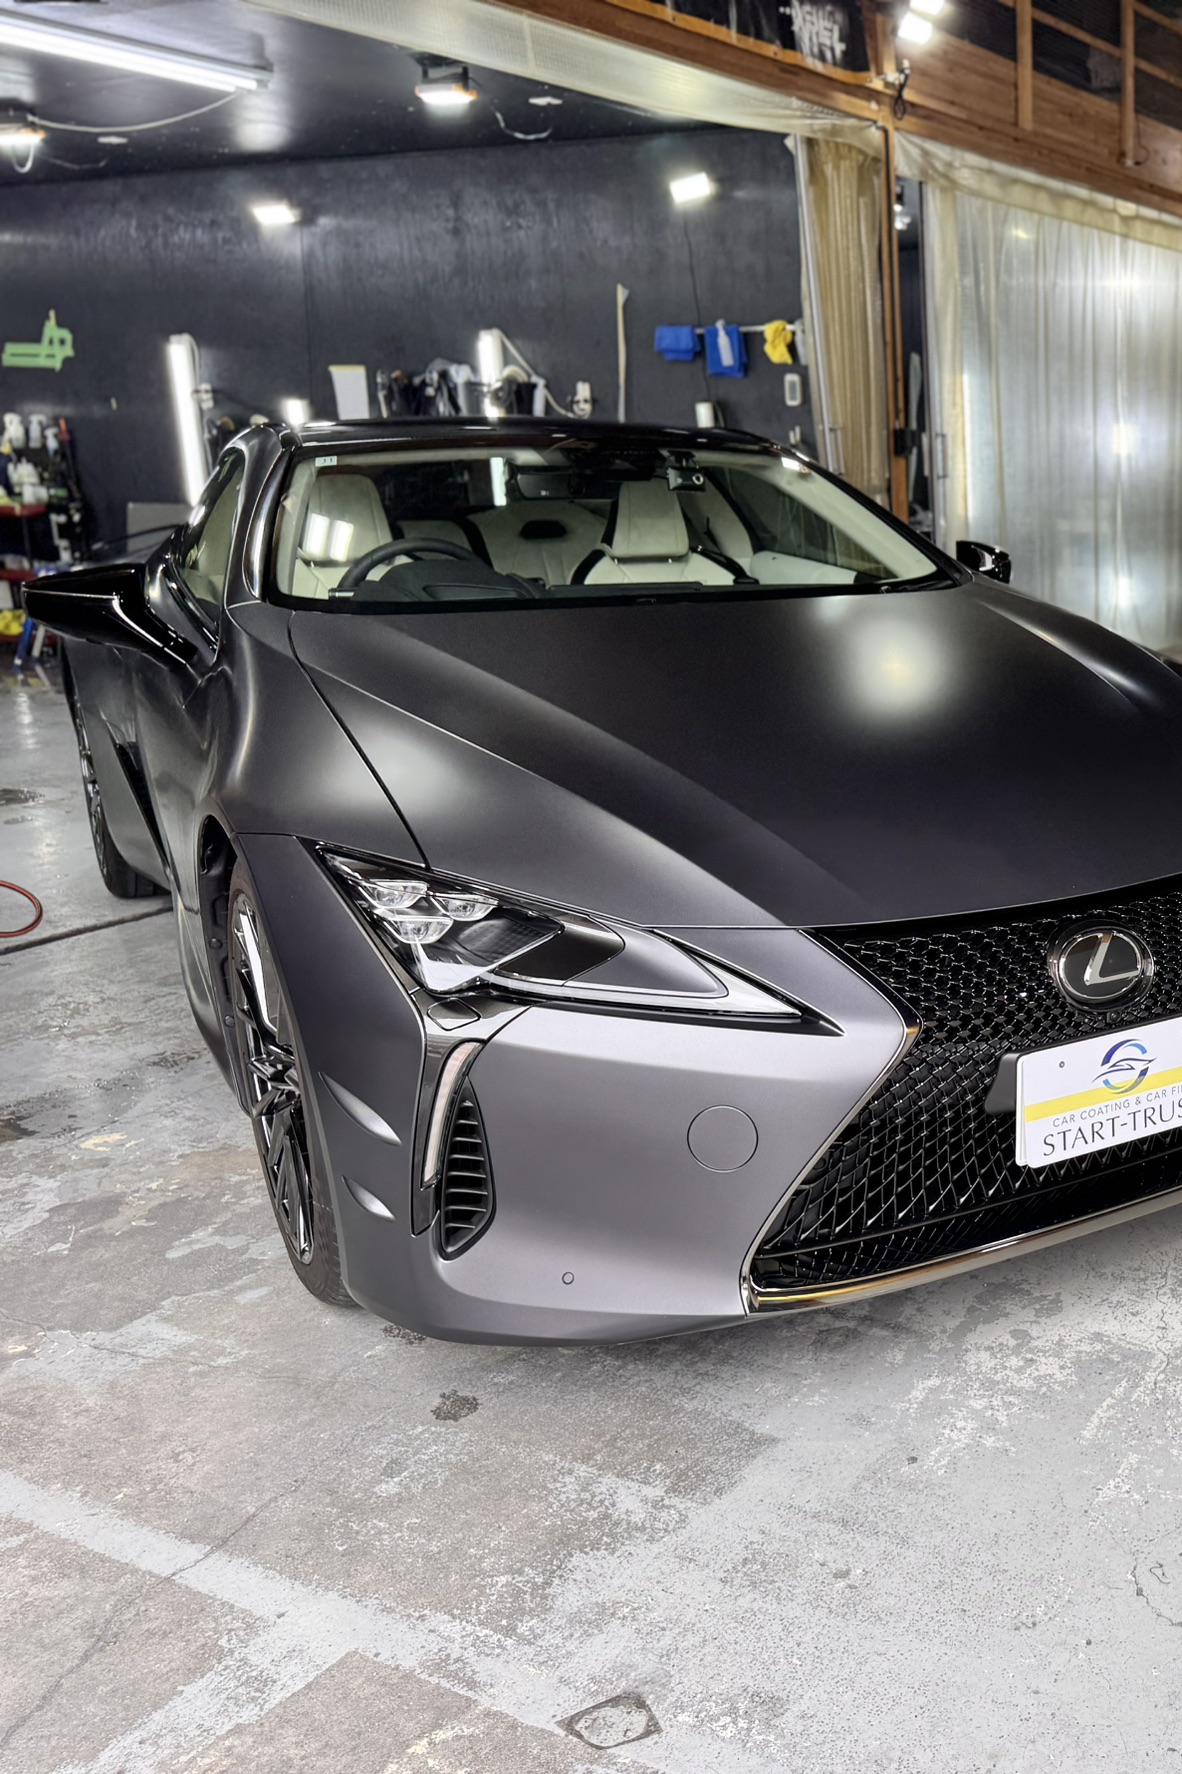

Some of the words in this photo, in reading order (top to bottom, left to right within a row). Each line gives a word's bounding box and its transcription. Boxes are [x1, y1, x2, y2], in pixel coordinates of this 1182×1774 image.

[1052, 1113, 1076, 1128] CAR
[1079, 1098, 1131, 1121] COATING
[1135, 1096, 1142, 1106] &
[1146, 1088, 1168, 1103] CAR
